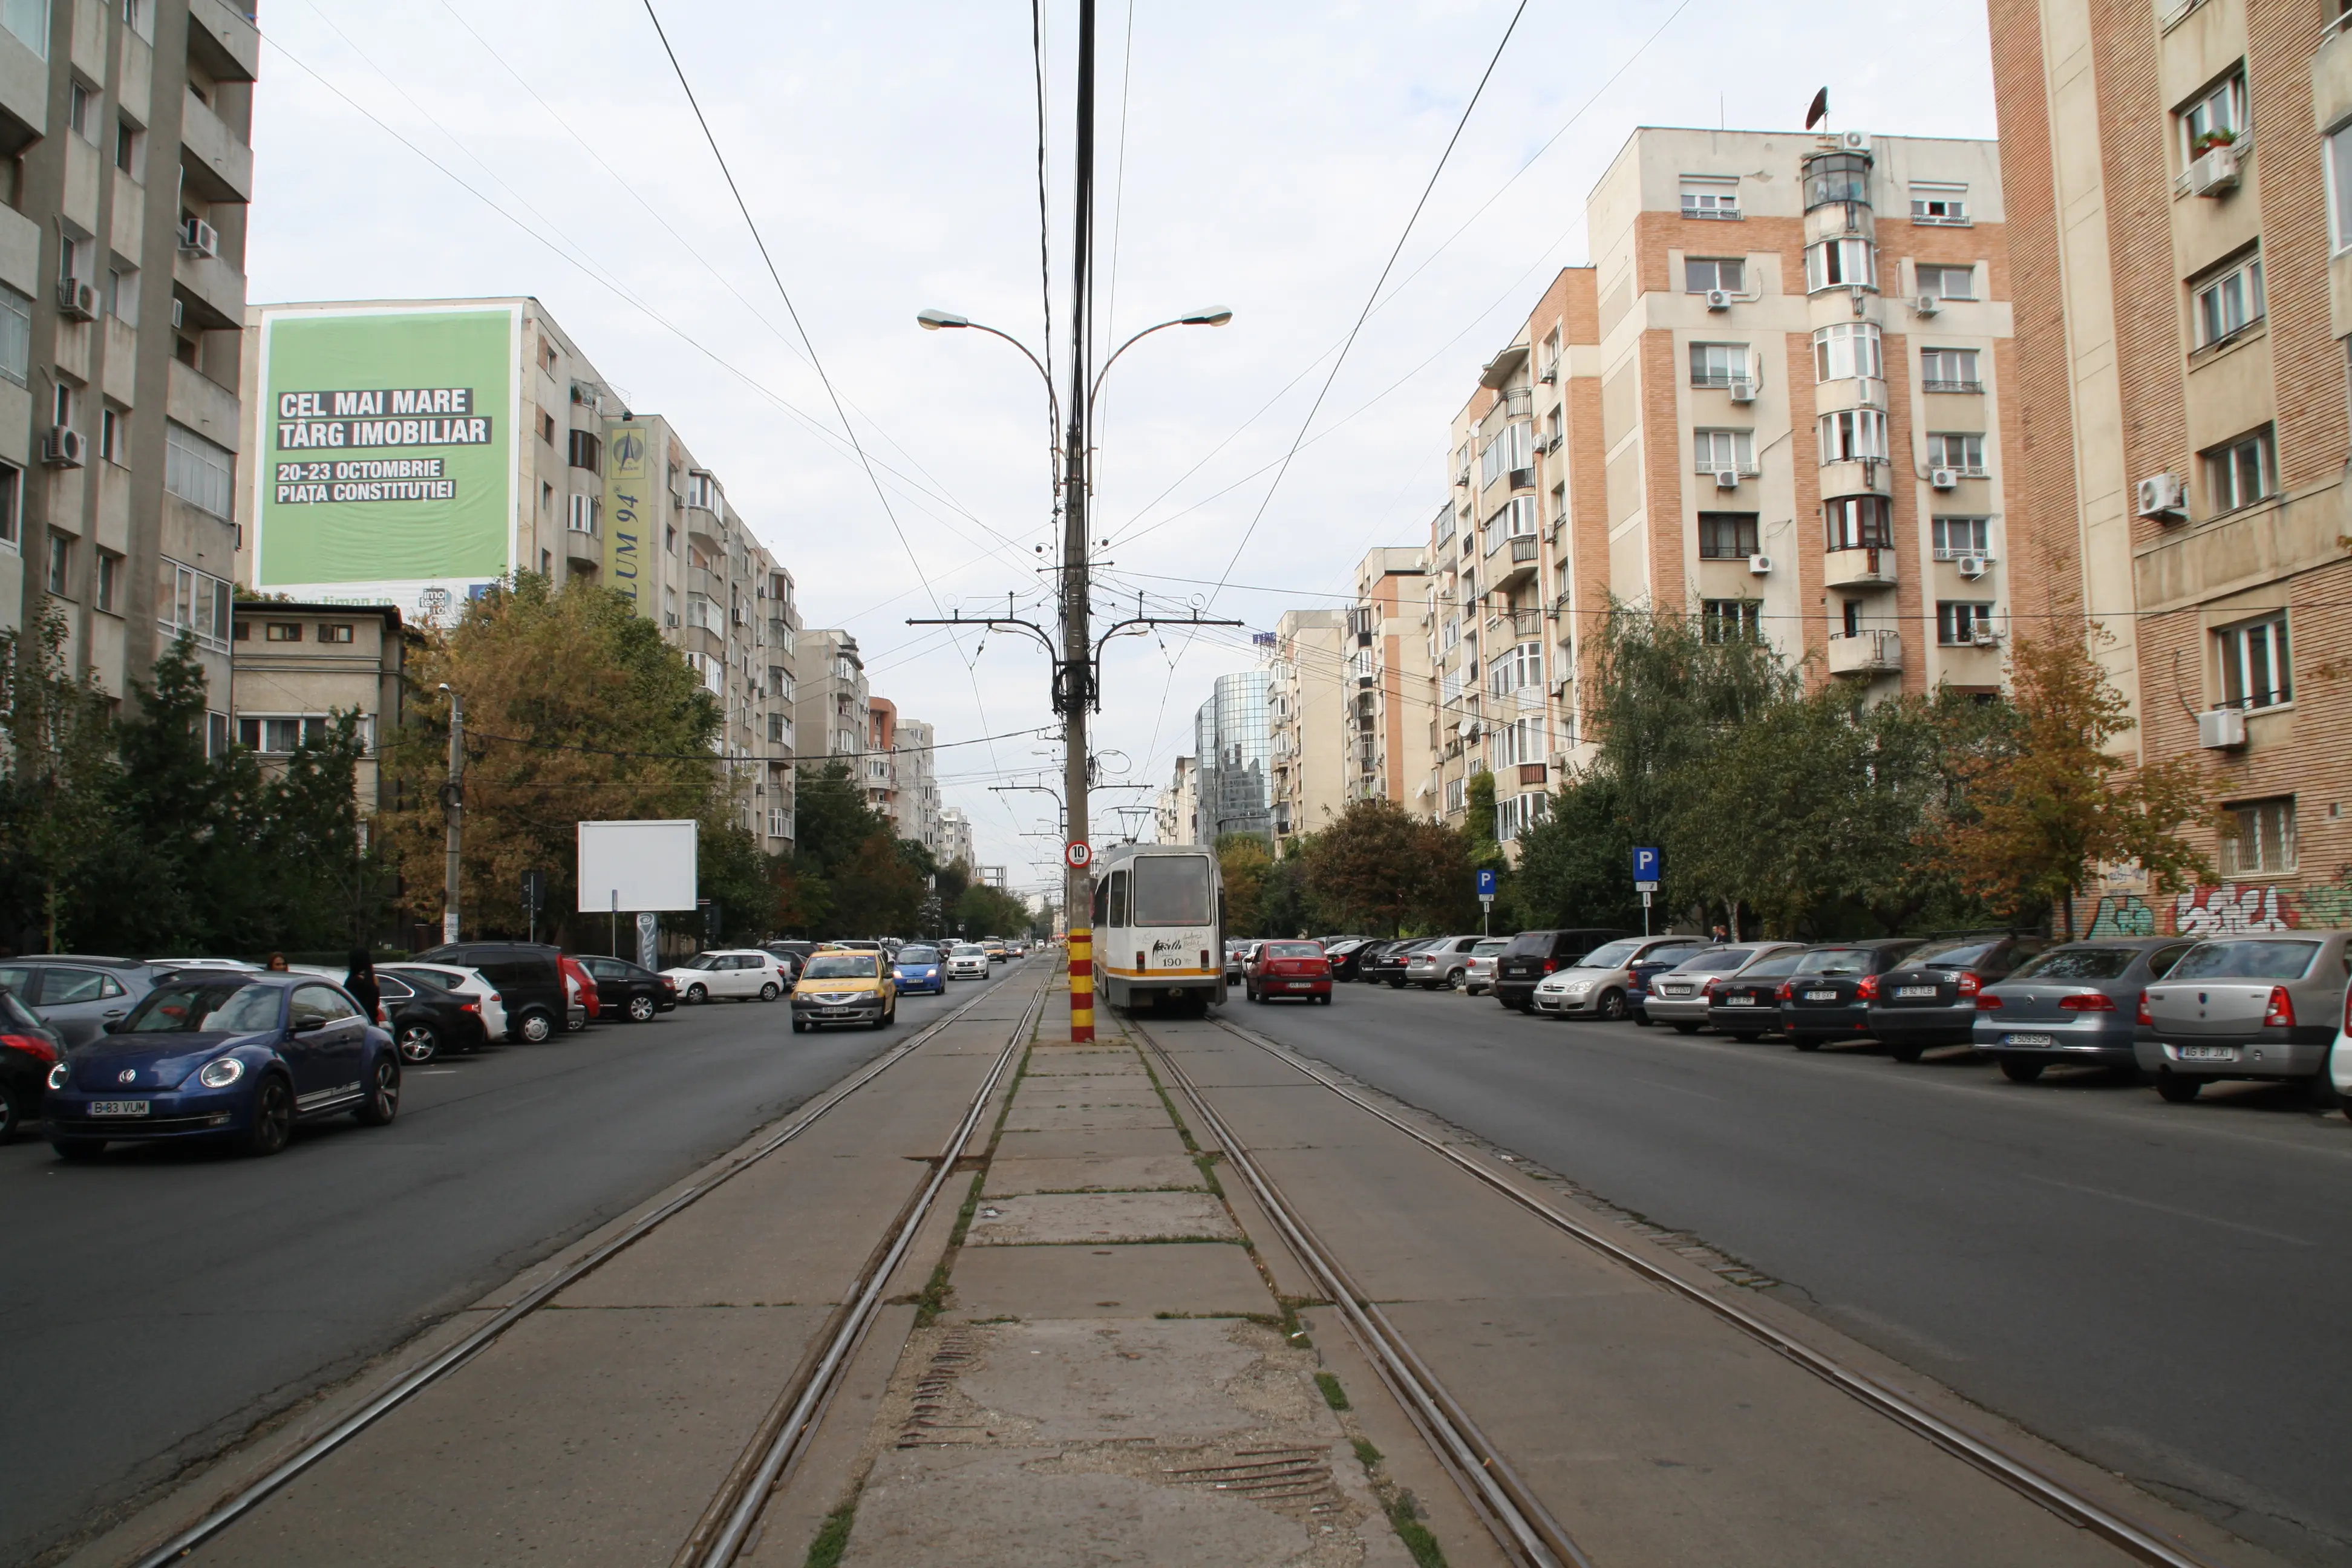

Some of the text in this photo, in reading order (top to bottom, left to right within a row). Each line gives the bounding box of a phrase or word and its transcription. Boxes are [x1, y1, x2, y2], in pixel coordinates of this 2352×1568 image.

[281, 389, 466, 417] CEL MAI MARE
[279, 419, 486, 447] TÂRG IMOBILIAR
[278, 460, 440, 481] 20-23 OCTOMBRIE
[616, 494, 638, 523] 94
[616, 530, 638, 619] LUM
[424, 589, 445, 599] imo
[1073, 846, 1084, 858] 10
[1639, 851, 1653, 870] P
[1481, 873, 1491, 886] P
[1163, 958, 1181, 967] 190
[2185, 1047, 2197, 1056] AG
[2200, 1047, 2209, 1057] 81
[95, 1102, 145, 1113] B 83 VUM
